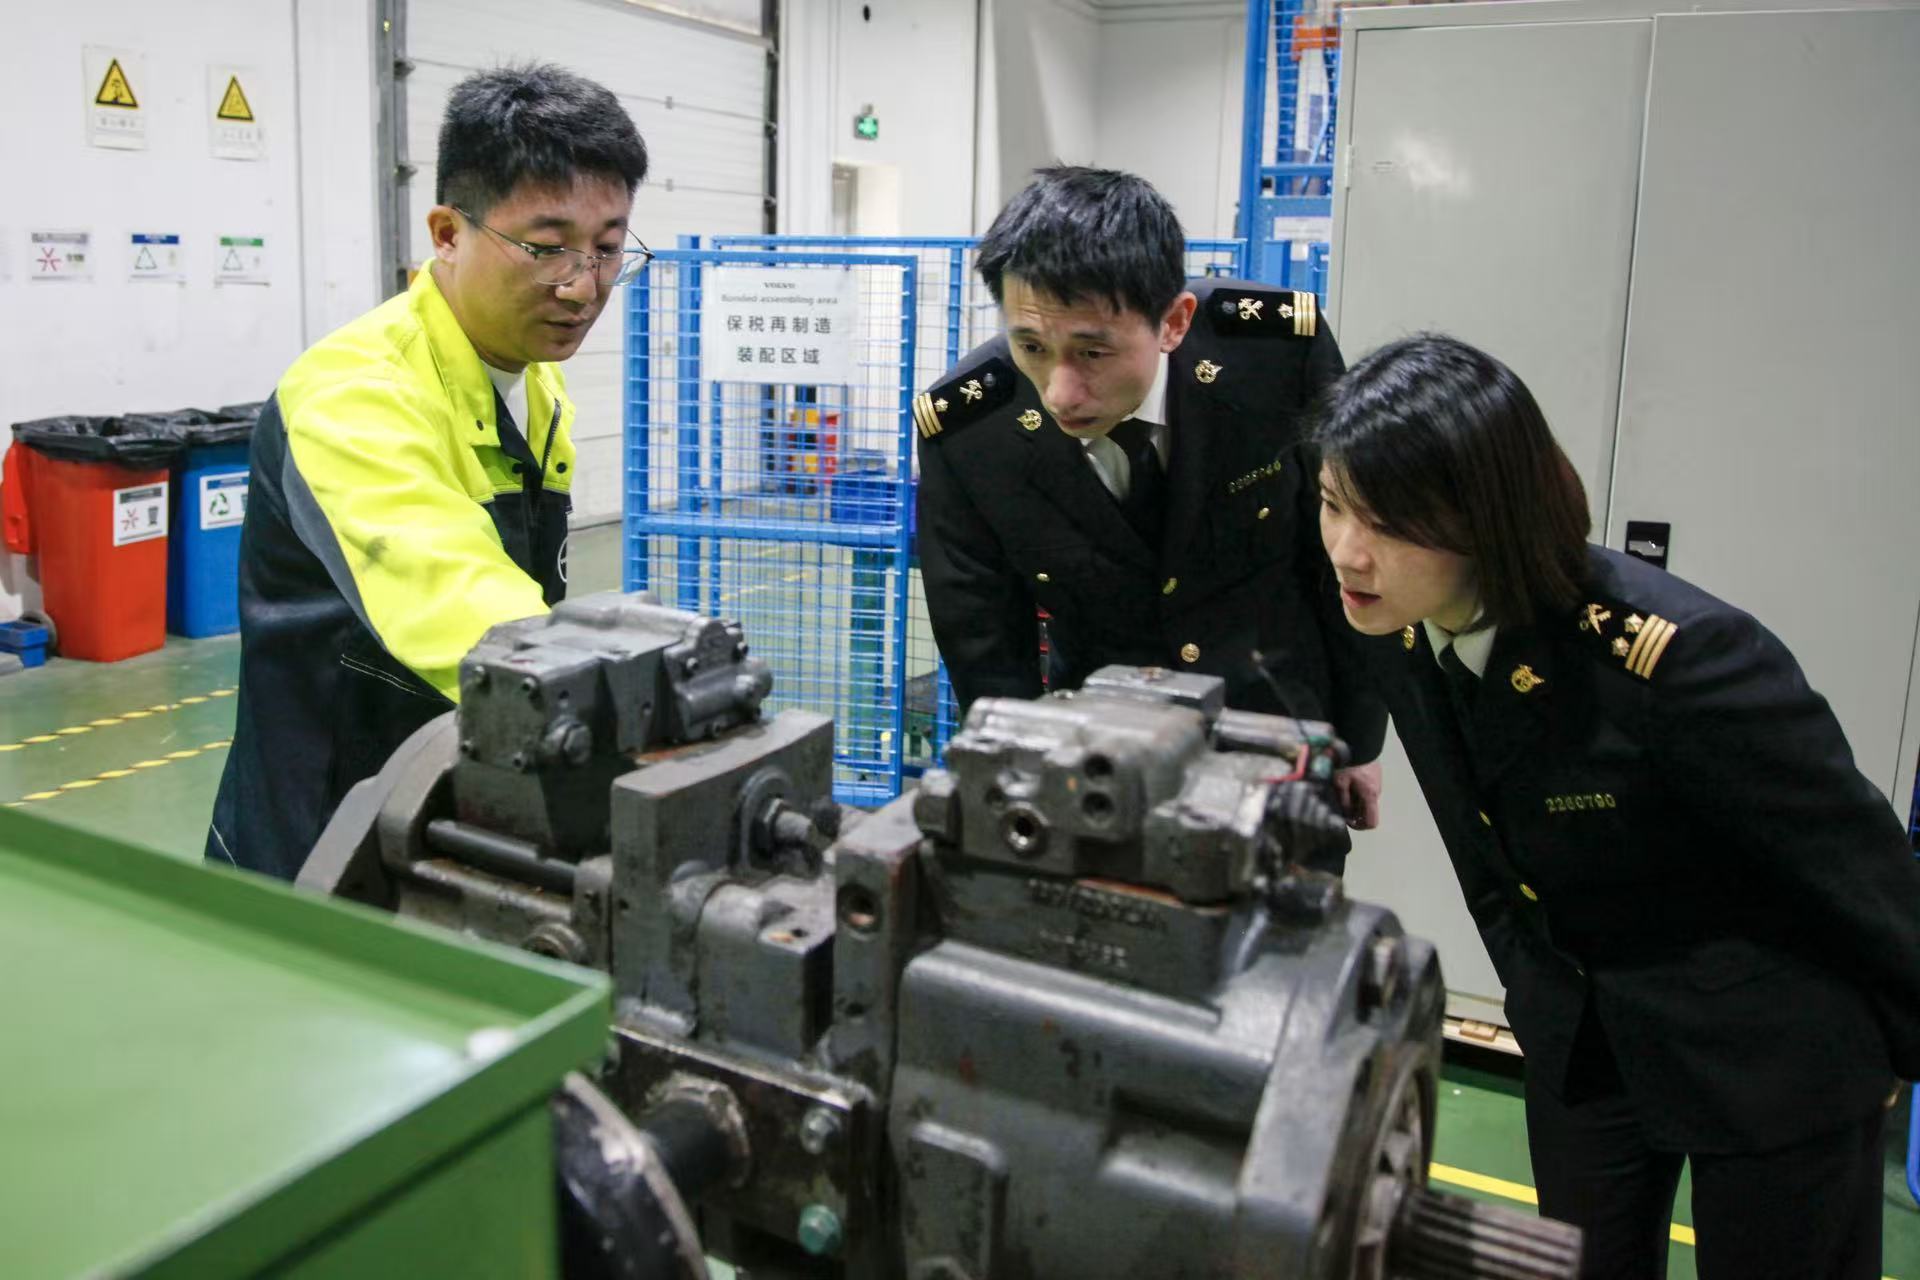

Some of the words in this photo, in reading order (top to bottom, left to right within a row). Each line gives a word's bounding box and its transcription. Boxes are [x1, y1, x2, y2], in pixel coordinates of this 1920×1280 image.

[727, 315, 832, 334] 保税再制造
[737, 347, 820, 365] 装配区域
